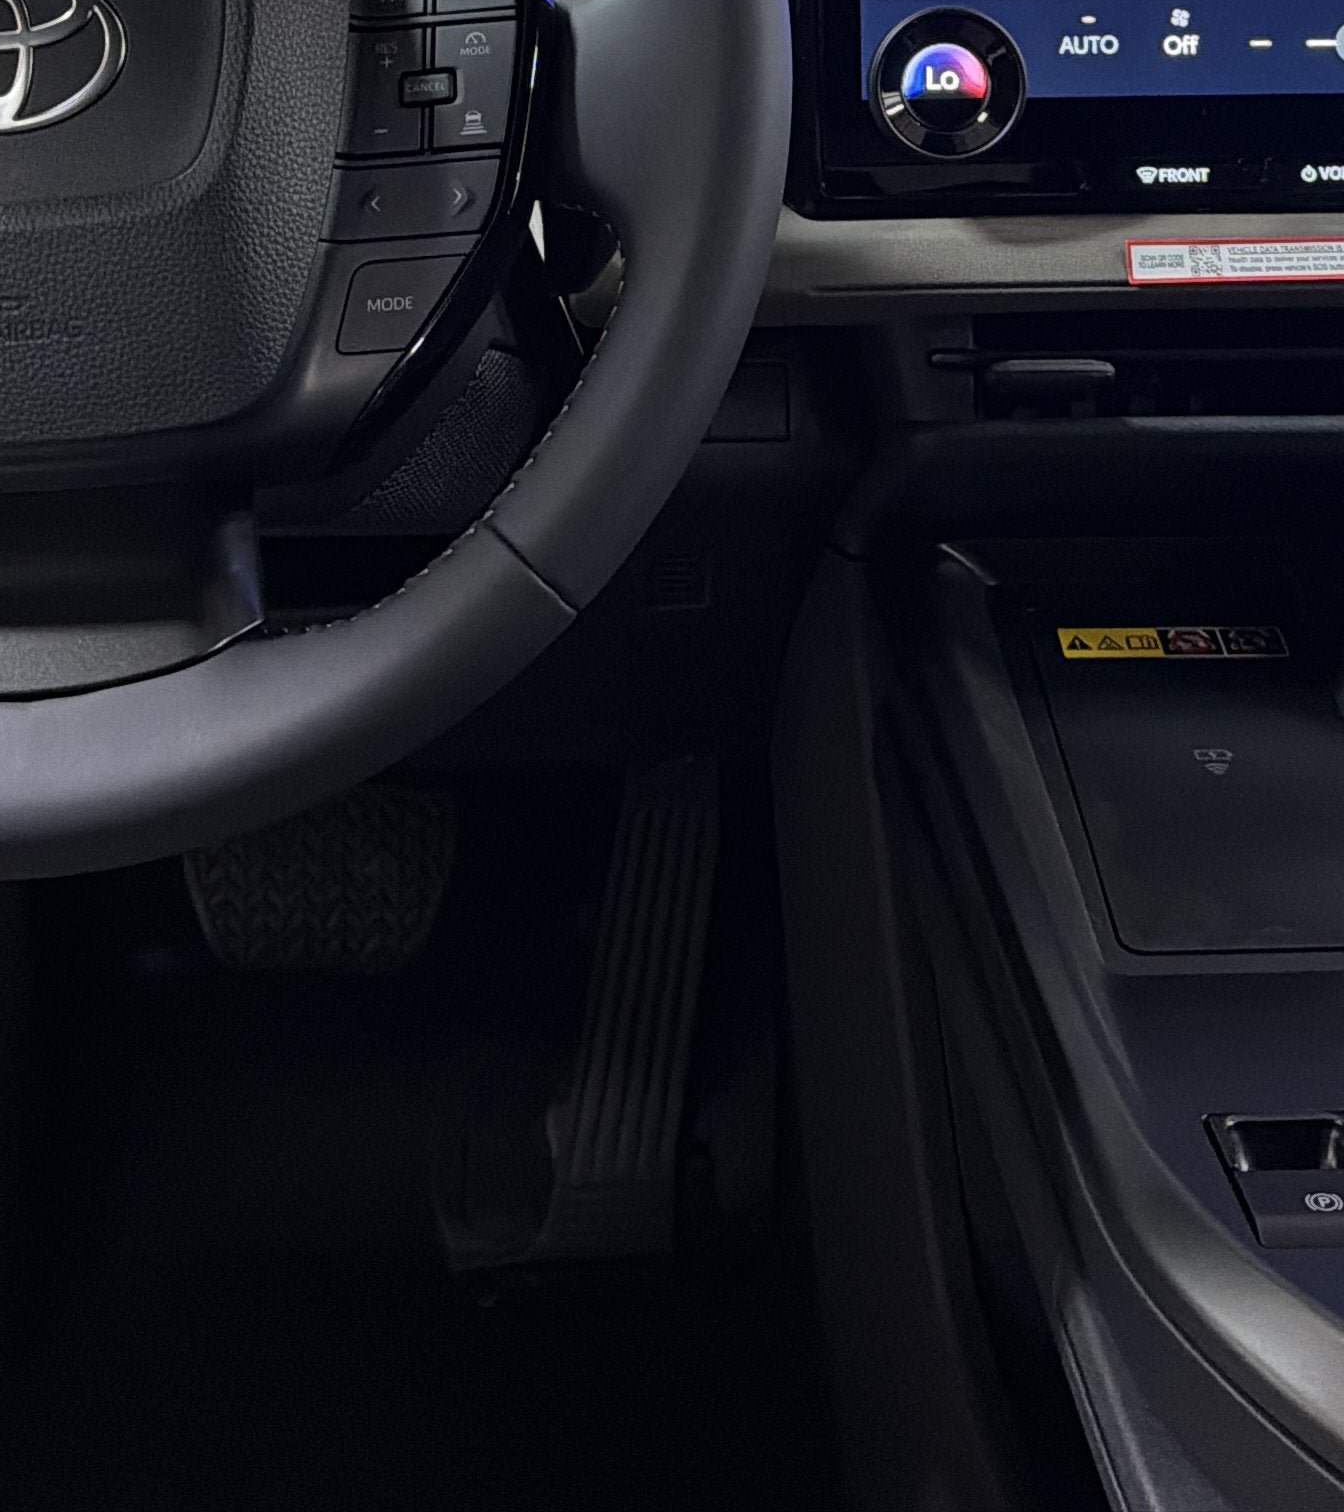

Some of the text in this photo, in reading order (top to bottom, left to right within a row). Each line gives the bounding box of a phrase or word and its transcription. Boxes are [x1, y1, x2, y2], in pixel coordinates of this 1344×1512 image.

[460, 46, 490, 56] MODE
[1058, 35, 1119, 55] AUTO
[1163, 34, 1200, 55] Off
[925, 66, 959, 89] Lo
[406, 82, 446, 92] CANCEL
[1158, 167, 1210, 183] FRONT
[367, 295, 414, 312] MODE
